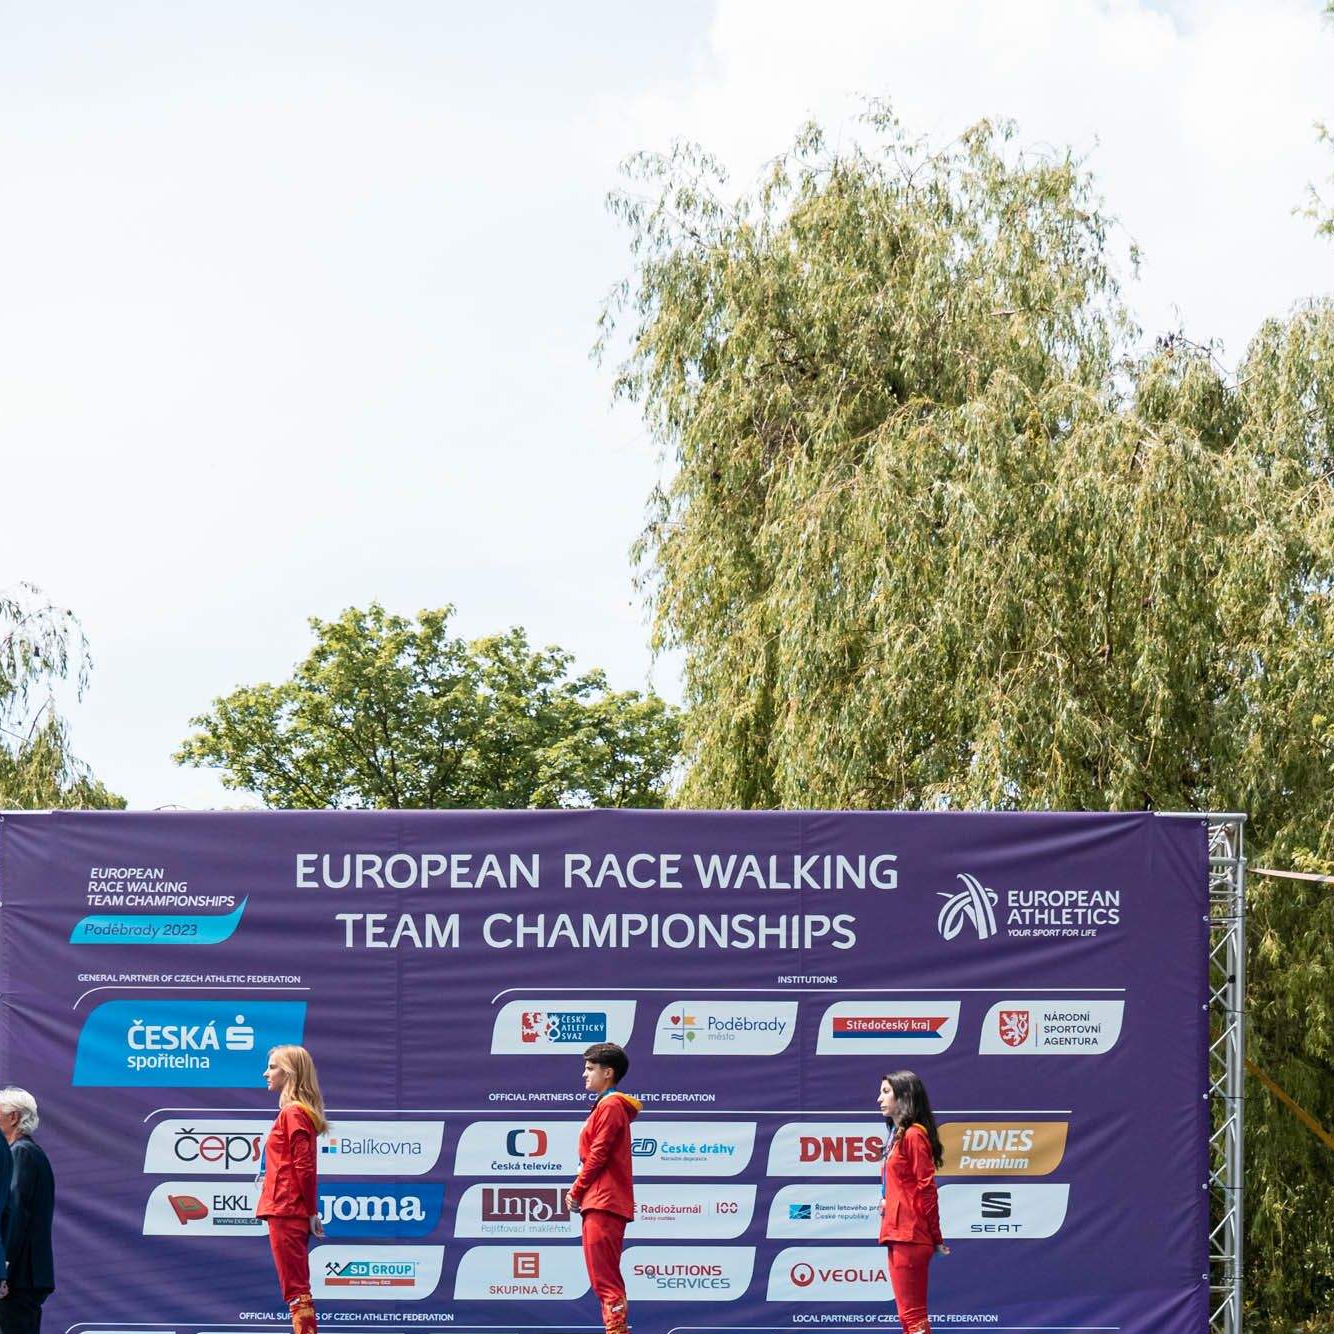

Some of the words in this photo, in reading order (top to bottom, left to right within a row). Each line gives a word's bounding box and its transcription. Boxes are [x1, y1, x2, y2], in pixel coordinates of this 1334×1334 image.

[90, 867, 165, 880] EUROPEAN
[296, 853, 540, 889] EUROPEAN
[564, 853, 683, 889] RACE
[693, 854, 898, 890] WALKING
[88, 881, 124, 893] RACE
[127, 881, 188, 893] WALKING
[87, 895, 126, 906] TEAM
[126, 895, 235, 907] CHAMPIONSHIPS
[1007, 890, 1120, 907] EUROPEAN
[1007, 908, 1120, 925] ATHLETICS
[84, 923, 161, 939] Poděbrady
[162, 924, 198, 936] 2023
[335, 913, 460, 949] TEAM
[482, 913, 857, 949] CHAMPIONSHIPS
[1008, 929, 1031, 937] YOUR
[1032, 929, 1061, 937] SPORT
[1062, 929, 1079, 937] FOR
[1080, 929, 1097, 937] LIFE
[77, 974, 118, 982] GENERAL
[119, 974, 160, 983] PARTNER
[161, 975, 173, 983] OF
[174, 975, 203, 983] CZECH
[204, 975, 245, 983] ATHLETIC
[777, 976, 838, 984] INSTITUTIONS
[561, 1014, 587, 1024] ČESKÝ
[1044, 1011, 1090, 1022] NÁRODNÍ
[561, 1023, 605, 1032] ATLETICKÝ
[708, 1016, 787, 1036] Poděbrady
[846, 1018, 909, 1032] Středočeský
[911, 1019, 930, 1032] kraj
[1044, 1023, 1101, 1034] SPORTOVNÍ
[127, 1019, 220, 1050] ČESKÁ
[561, 1032, 583, 1040] SVAZ
[1044, 1037, 1099, 1046] AGENTURA
[127, 1053, 210, 1071] spořitelna
[489, 1093, 532, 1101] OFFICIAL
[533, 1093, 574, 1101] PARTNERS
[575, 1093, 587, 1101] OF
[661, 1093, 716, 1102] FEDERATION
[341, 1138, 422, 1154] Balíkovna
[962, 1129, 1034, 1151] iDNES
[661, 1142, 696, 1154] České
[699, 1144, 735, 1157] dráhy
[799, 1136, 883, 1163] DNES
[491, 1160, 520, 1171] Česká
[522, 1162, 562, 1171] televize
[959, 1154, 1028, 1169] Premium
[213, 1195, 252, 1210] EKKL
[641, 1203, 701, 1213] Radiožurnál
[970, 1224, 1023, 1232] SEAT
[350, 1265, 366, 1274] SD
[372, 1265, 412, 1275] GROUP
[634, 1265, 722, 1275] SOLUTIONS
[819, 1269, 887, 1282] VEOLIA
[490, 1286, 538, 1294] SKUPINA
[541, 1283, 563, 1295] ČEZ
[656, 1278, 731, 1289] SERVICES
[239, 1312, 275, 1320] OFFICIAL
[321, 1313, 333, 1321] OF
[334, 1313, 361, 1321] CZECH
[362, 1313, 401, 1321] ATHLETIC
[402, 1313, 454, 1321] FEDERATION
